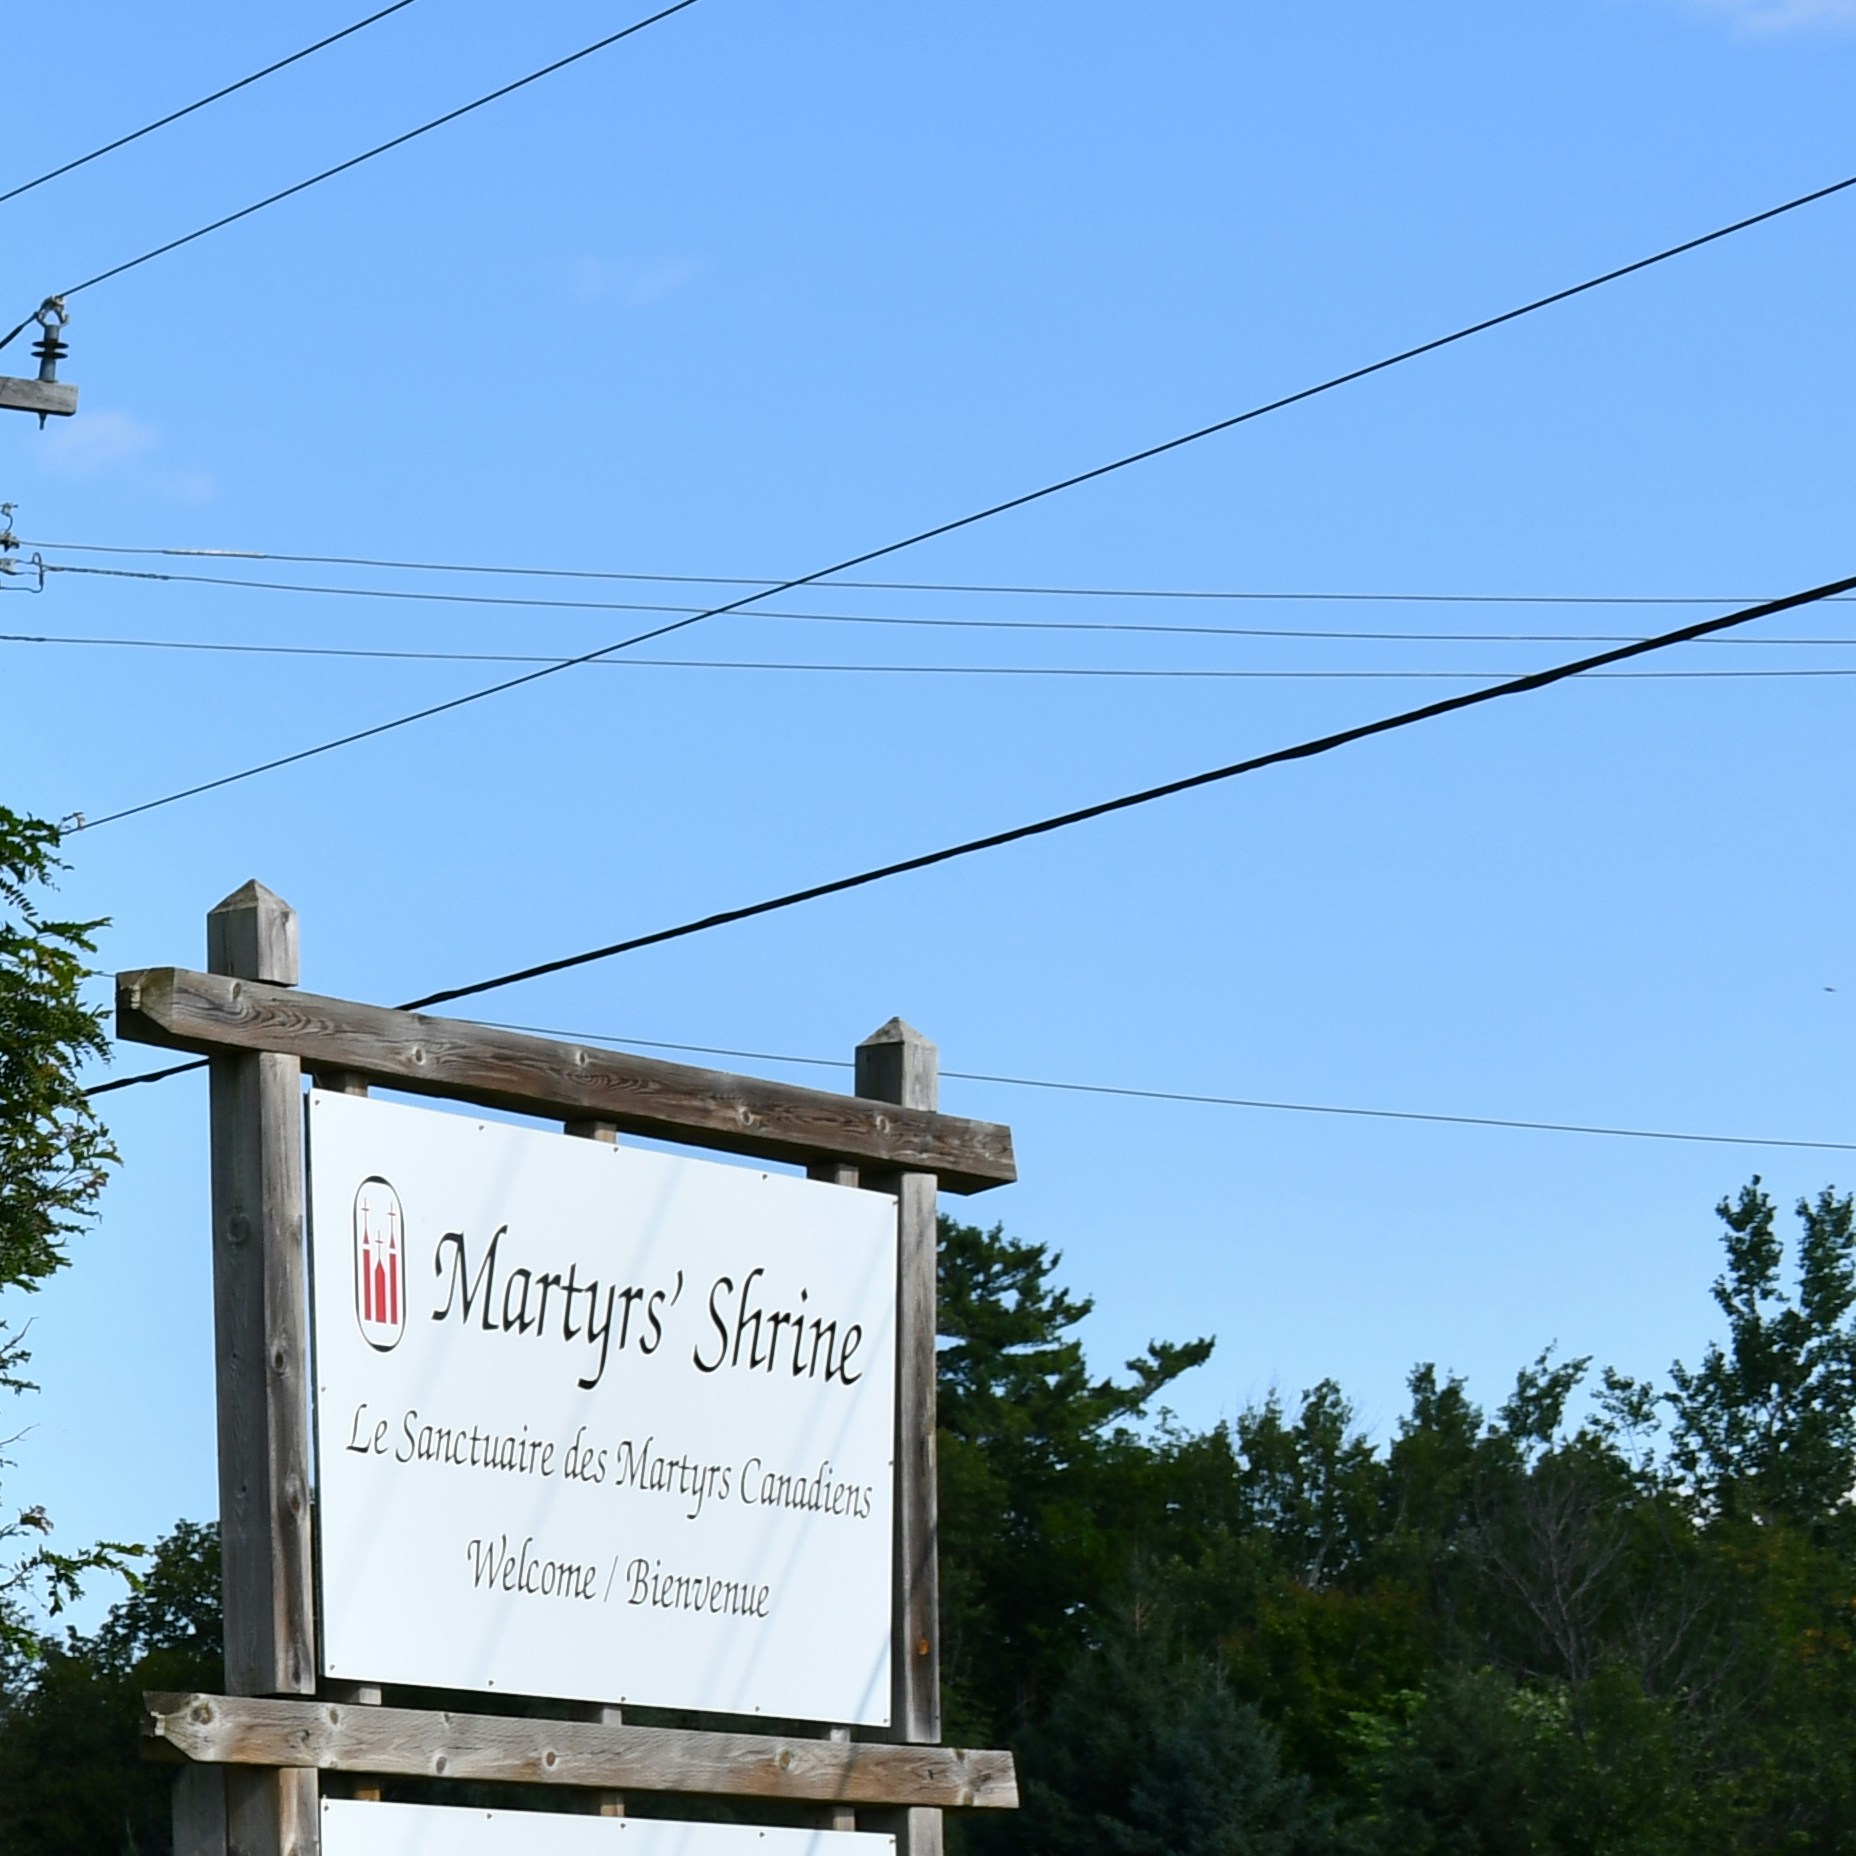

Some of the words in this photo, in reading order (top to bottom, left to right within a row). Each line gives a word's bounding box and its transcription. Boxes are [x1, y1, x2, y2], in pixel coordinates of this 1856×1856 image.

[431, 1224, 684, 1390] Martyrs'
[692, 1267, 864, 1386] Shrine
[345, 1403, 390, 1456] Le
[394, 1409, 556, 1479] Sanctuaire
[563, 1425, 608, 1485] des
[615, 1436, 732, 1521] Martyrs
[739, 1457, 874, 1520] Canadiens
[467, 1534, 598, 1602] Welcome
[626, 1556, 771, 1619] Bienvenue
